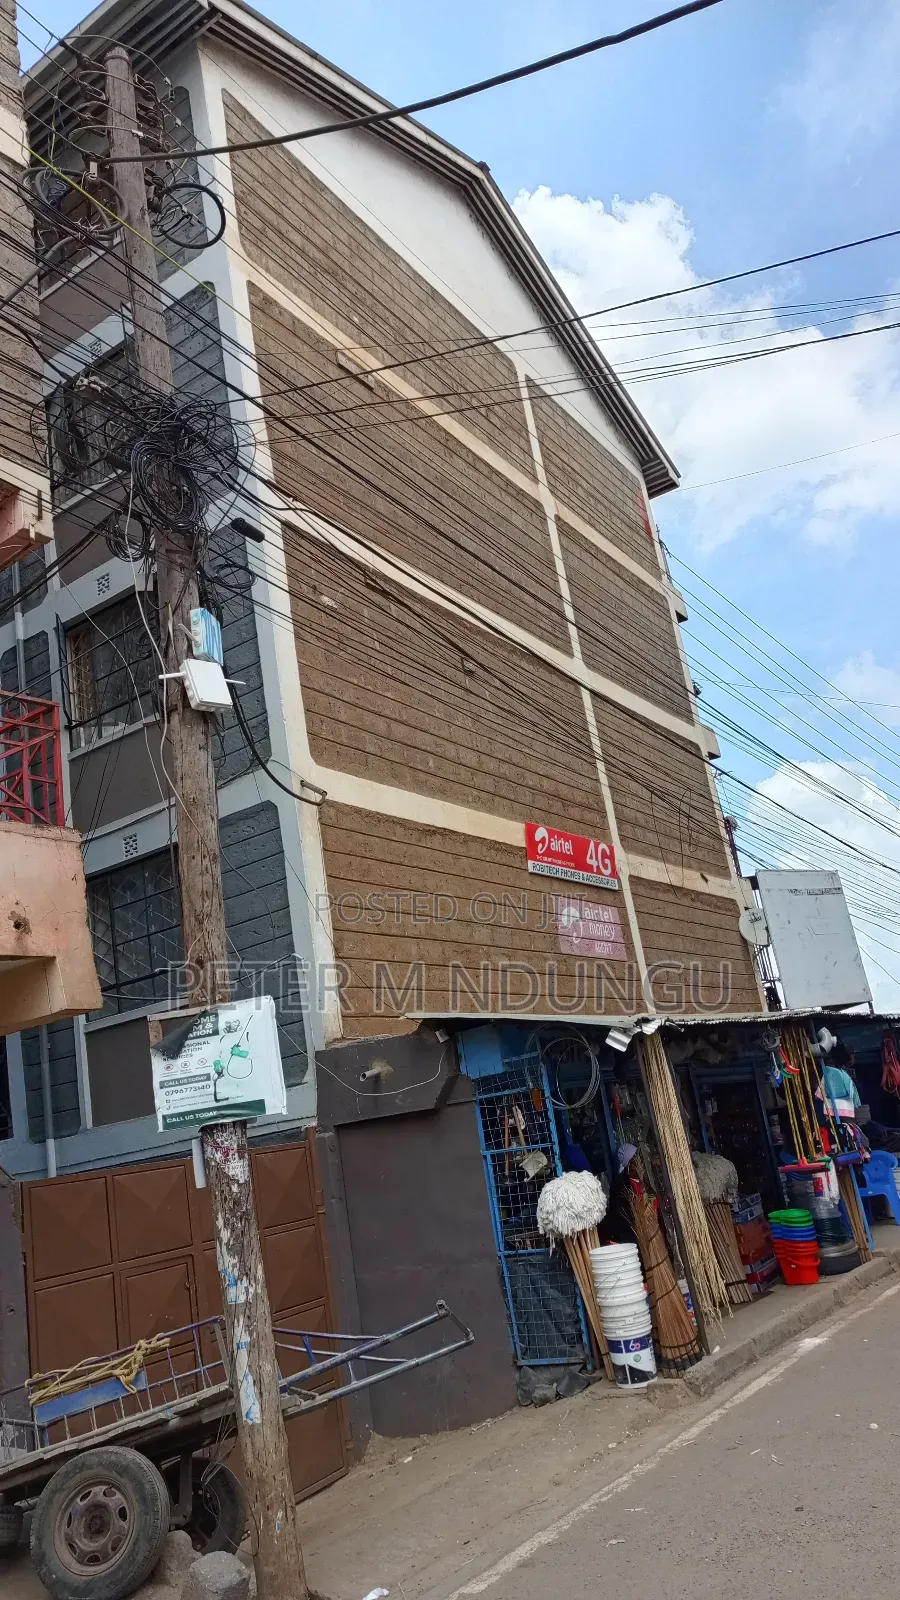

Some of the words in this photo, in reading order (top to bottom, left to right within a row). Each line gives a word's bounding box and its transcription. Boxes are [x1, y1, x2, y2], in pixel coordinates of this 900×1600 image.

[550, 835, 574, 856] airtel
[586, 840, 612, 876] 4G
[532, 863, 560, 876] ROBITECH
[560, 869, 581, 881] PHONES
[584, 905, 613, 923] airtel
[588, 921, 615, 940] money
[194, 1014, 217, 1024] OME
[189, 1074, 208, 1082] TODAY
[166, 1115, 184, 1124] CALL
[184, 1113, 194, 1121] US
[195, 1110, 218, 1119] TODAY
